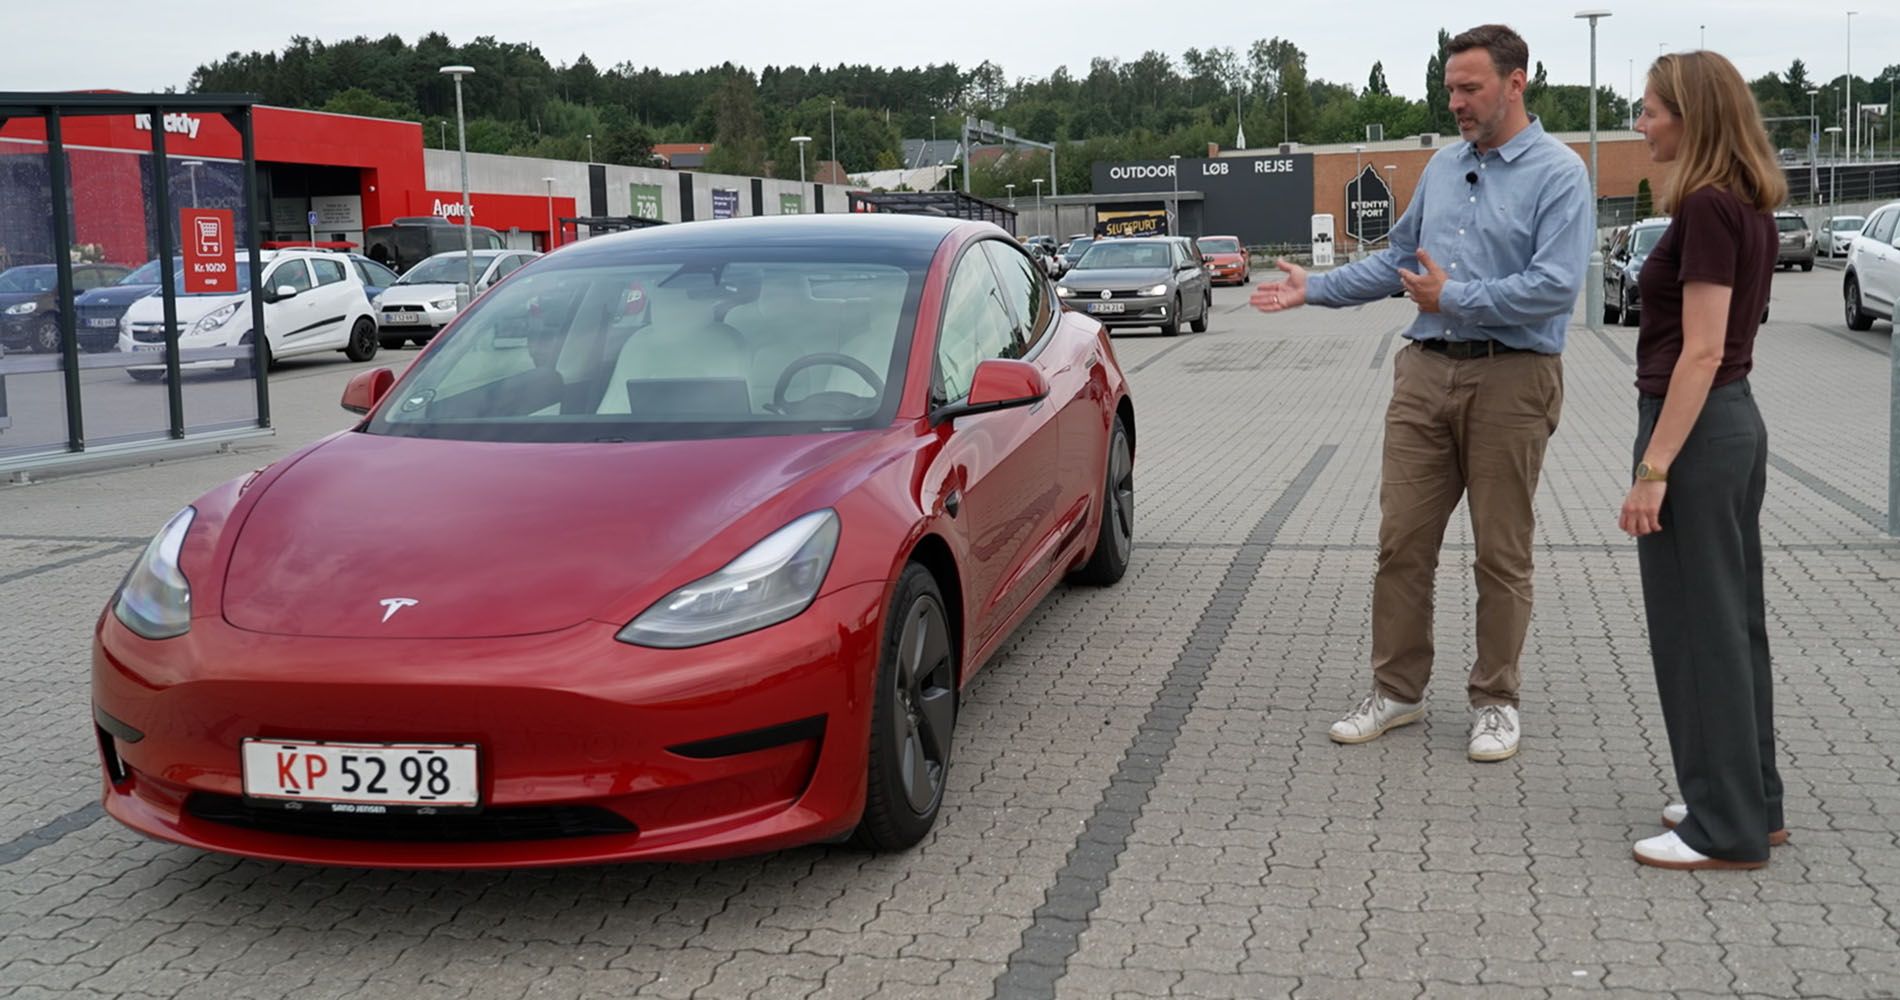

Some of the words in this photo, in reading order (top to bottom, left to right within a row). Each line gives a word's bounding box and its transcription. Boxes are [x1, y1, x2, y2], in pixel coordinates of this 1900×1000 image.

[1110, 165, 1176, 179] OUTDOOR
[1202, 163, 1229, 175] LØB
[1254, 160, 1293, 173] REJSE
[277, 752, 328, 790] KP
[341, 755, 388, 794] 52
[400, 756, 450, 795] 98
